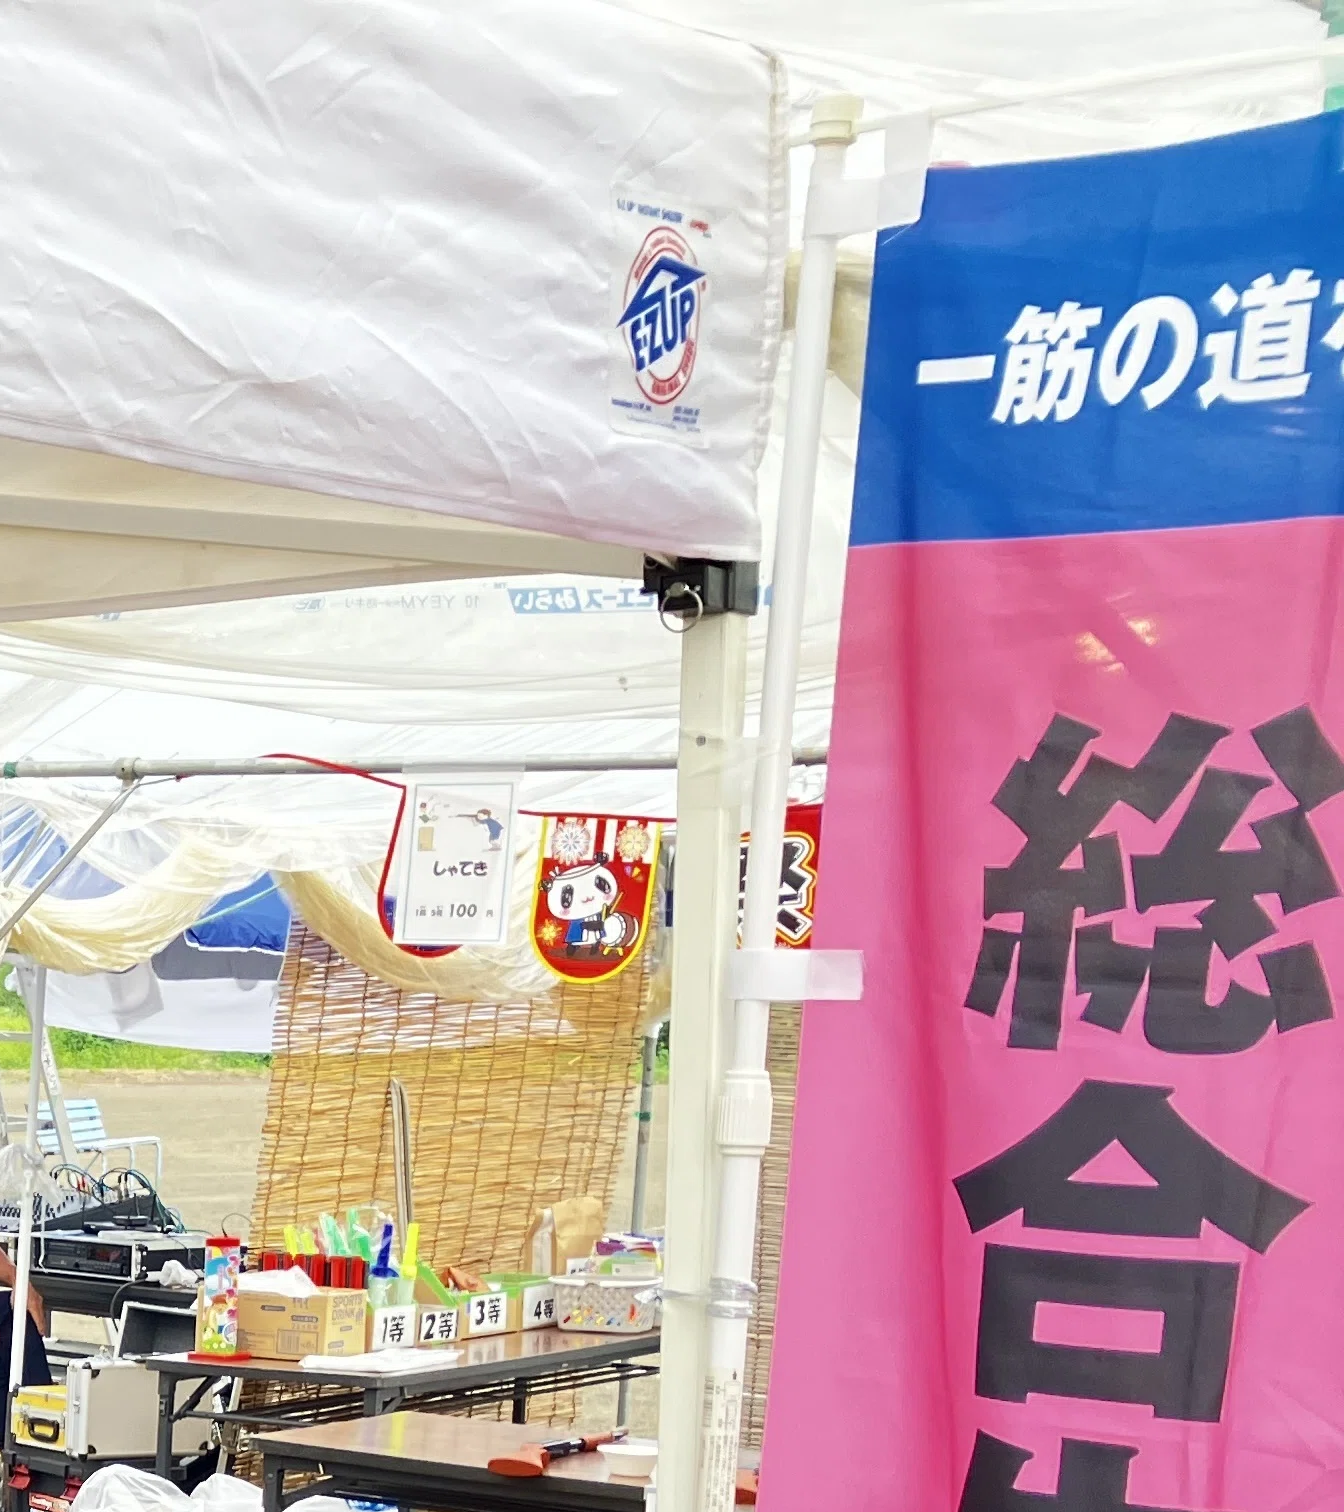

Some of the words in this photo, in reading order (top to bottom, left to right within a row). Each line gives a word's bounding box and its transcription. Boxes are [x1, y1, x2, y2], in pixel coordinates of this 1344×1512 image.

[917, 267, 1344, 426] 一筋の道
[433, 860, 488, 877] しゃてき
[449, 903, 477, 918] 100
[475, 1297, 502, 1325] 3等
[533, 1298, 554, 1320] 4等
[382, 1314, 406, 1343] 1等
[423, 1312, 454, 1340] 2等
